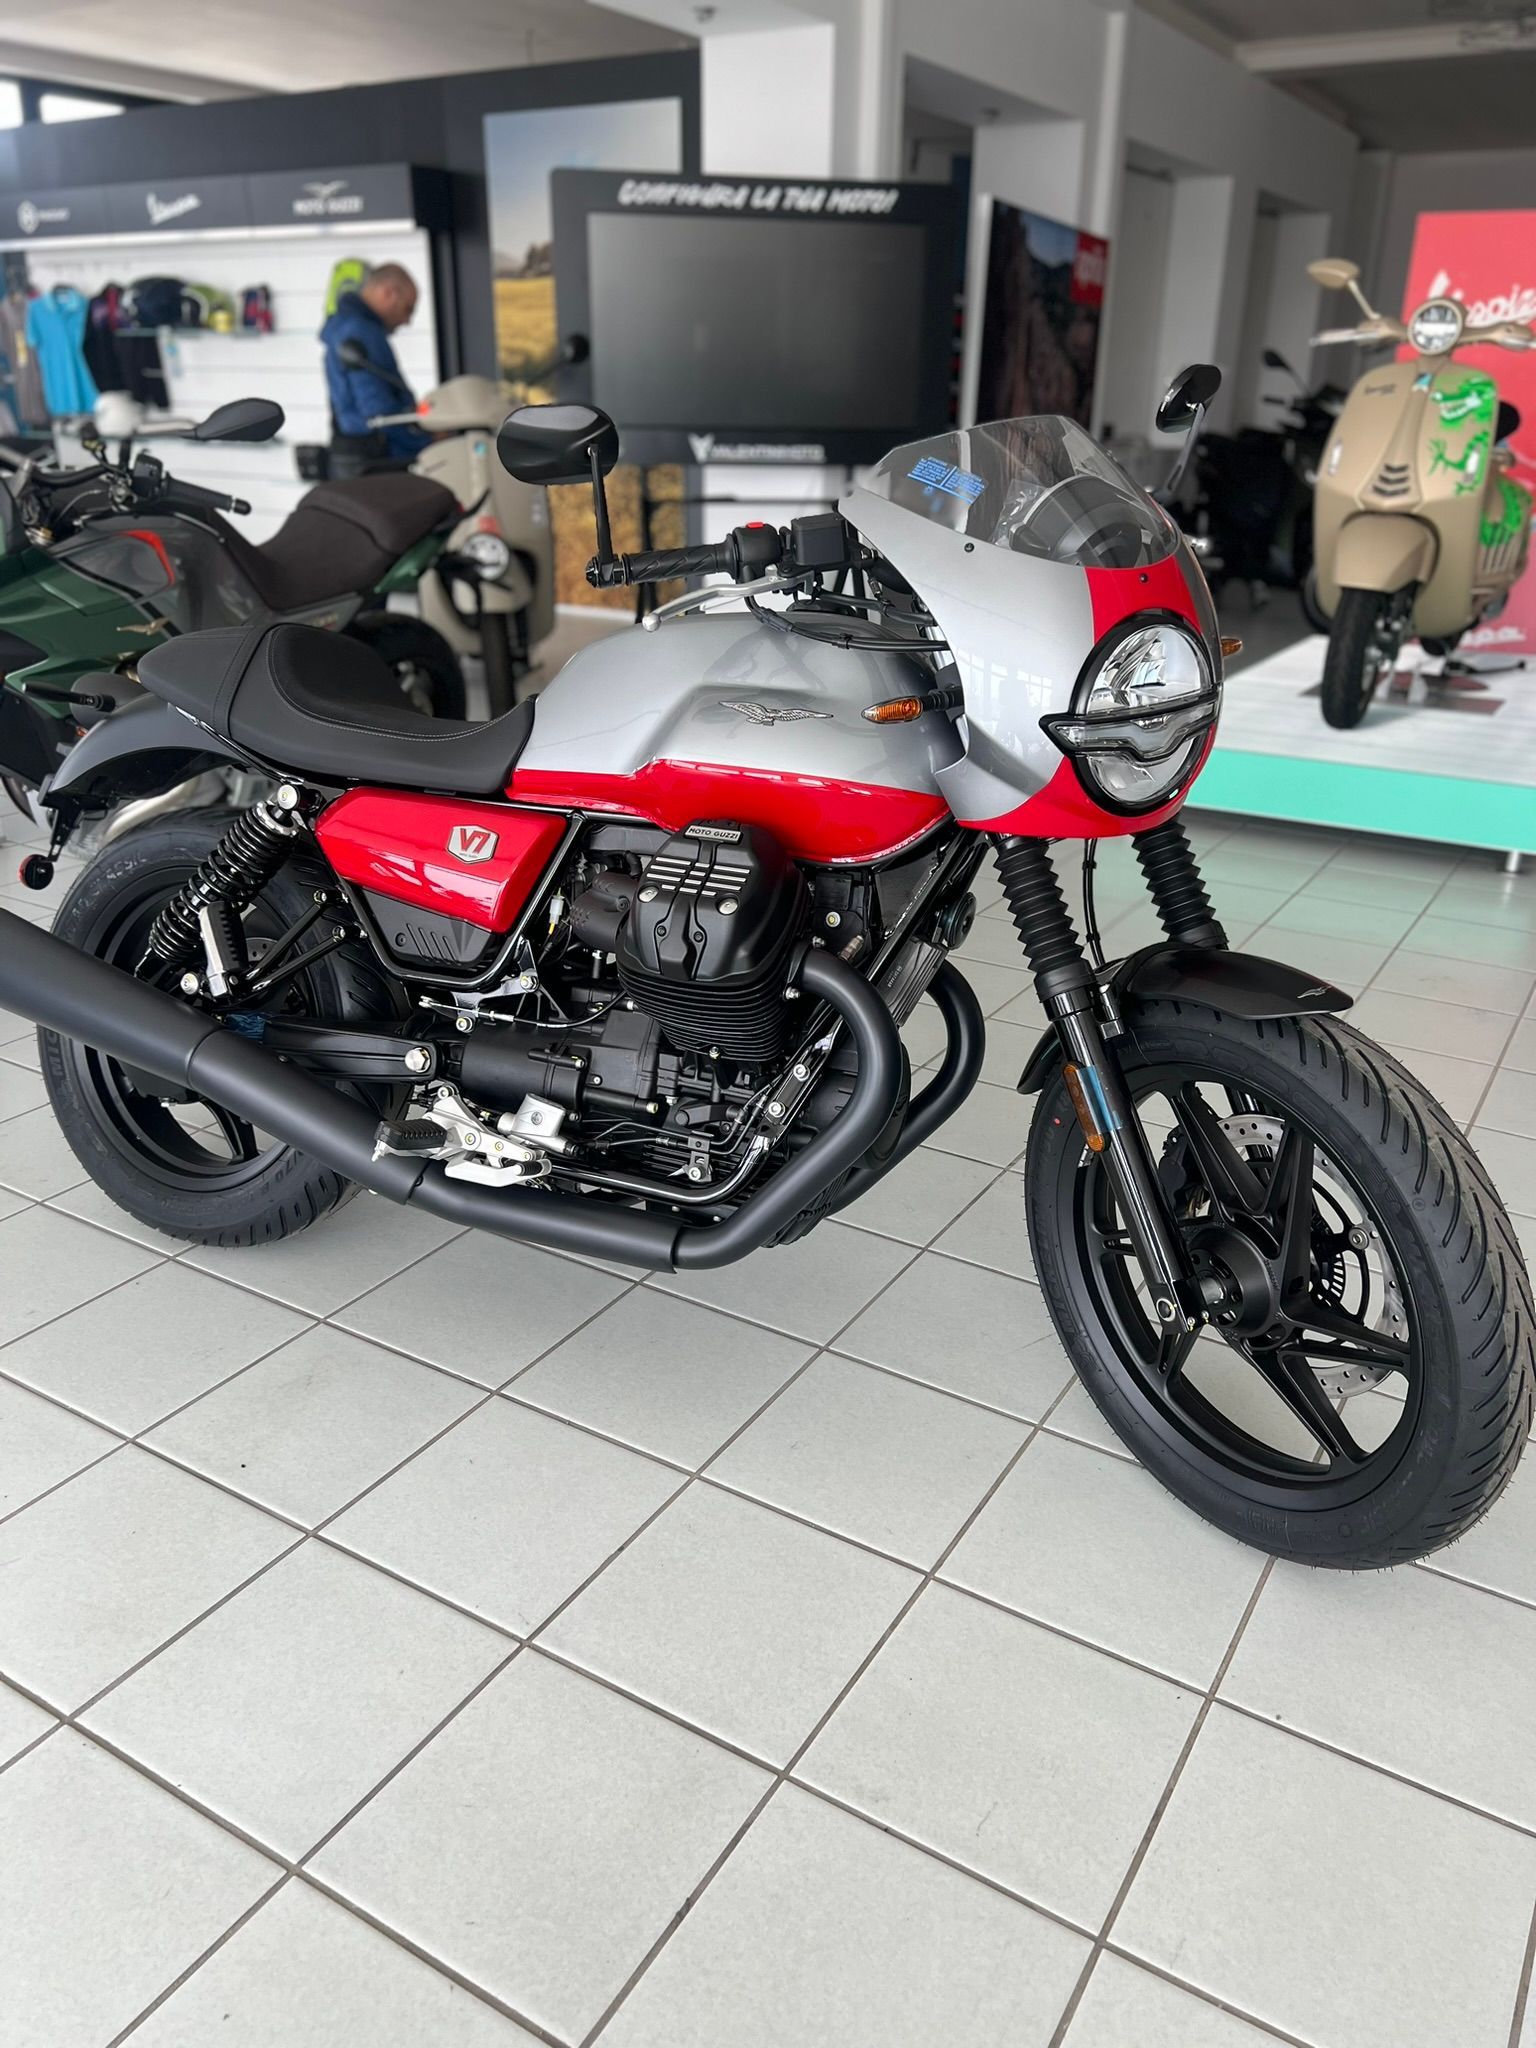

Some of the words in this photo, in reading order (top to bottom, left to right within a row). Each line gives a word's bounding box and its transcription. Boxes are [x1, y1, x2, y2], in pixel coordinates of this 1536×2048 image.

[750, 184, 780, 212] LA
[460, 828, 491, 853] V7
[688, 827, 712, 836] MOTO
[713, 830, 739, 839] GUZZI
